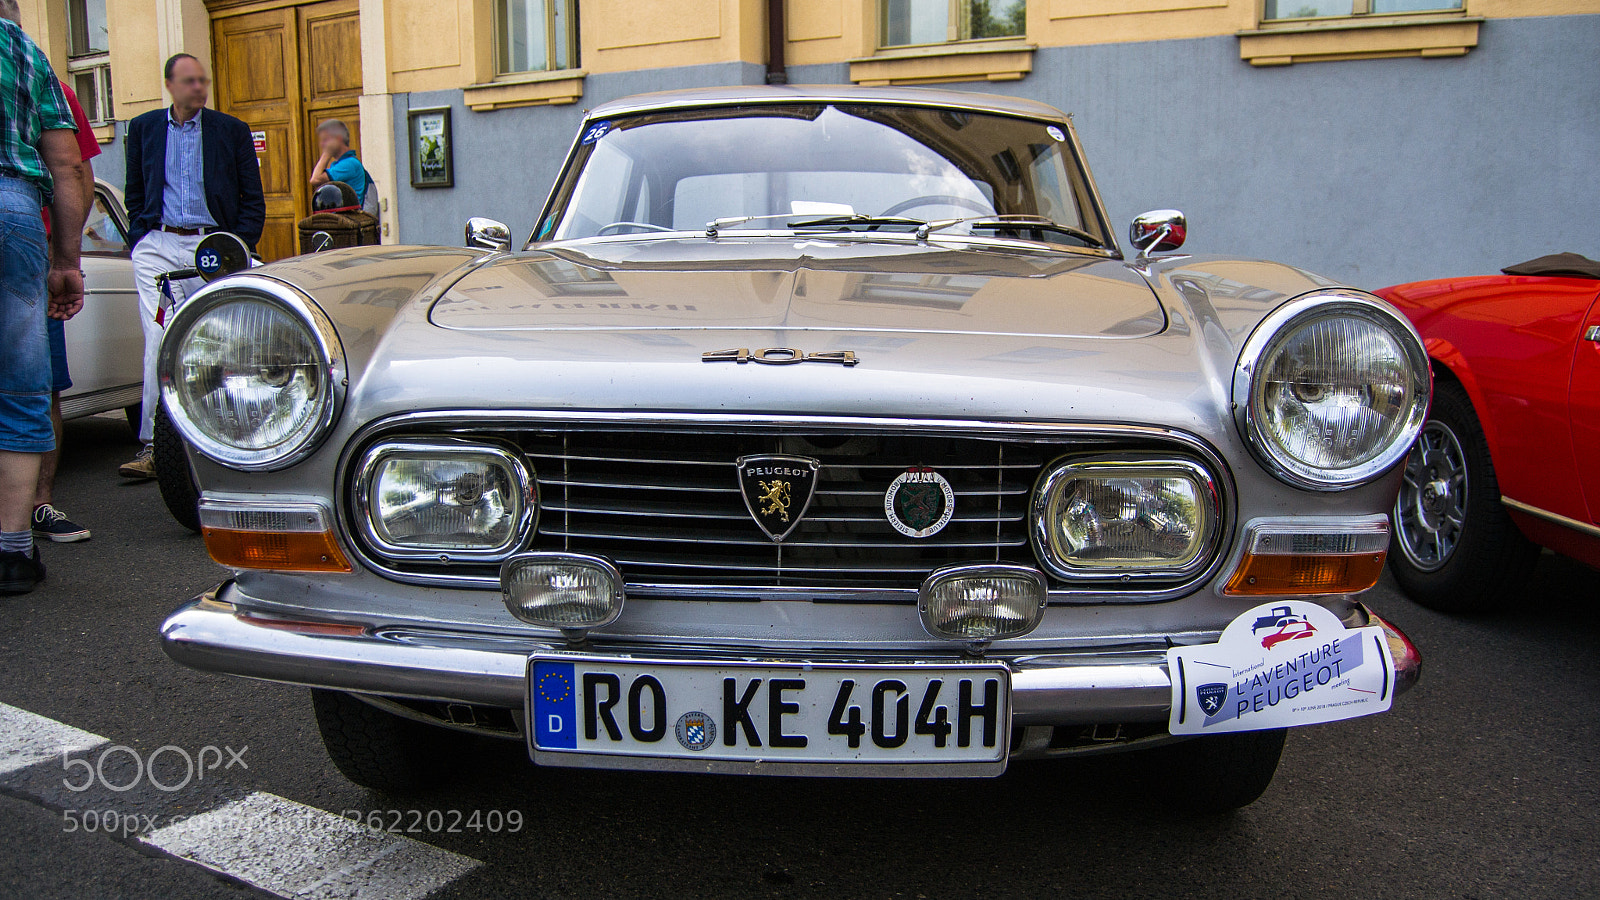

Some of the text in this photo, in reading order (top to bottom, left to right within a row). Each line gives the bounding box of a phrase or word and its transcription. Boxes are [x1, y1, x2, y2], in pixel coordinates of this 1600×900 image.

[585, 126, 608, 142] 26
[200, 254, 219, 268] 82
[701, 347, 859, 367] 404
[746, 466, 809, 478] PEUGEOT
[1236, 639, 1341, 696] L'AVENTURE
[1237, 658, 1344, 720] PEUGEOT
[583, 673, 999, 749] RO KE 404H
[549, 716, 562, 733] D
